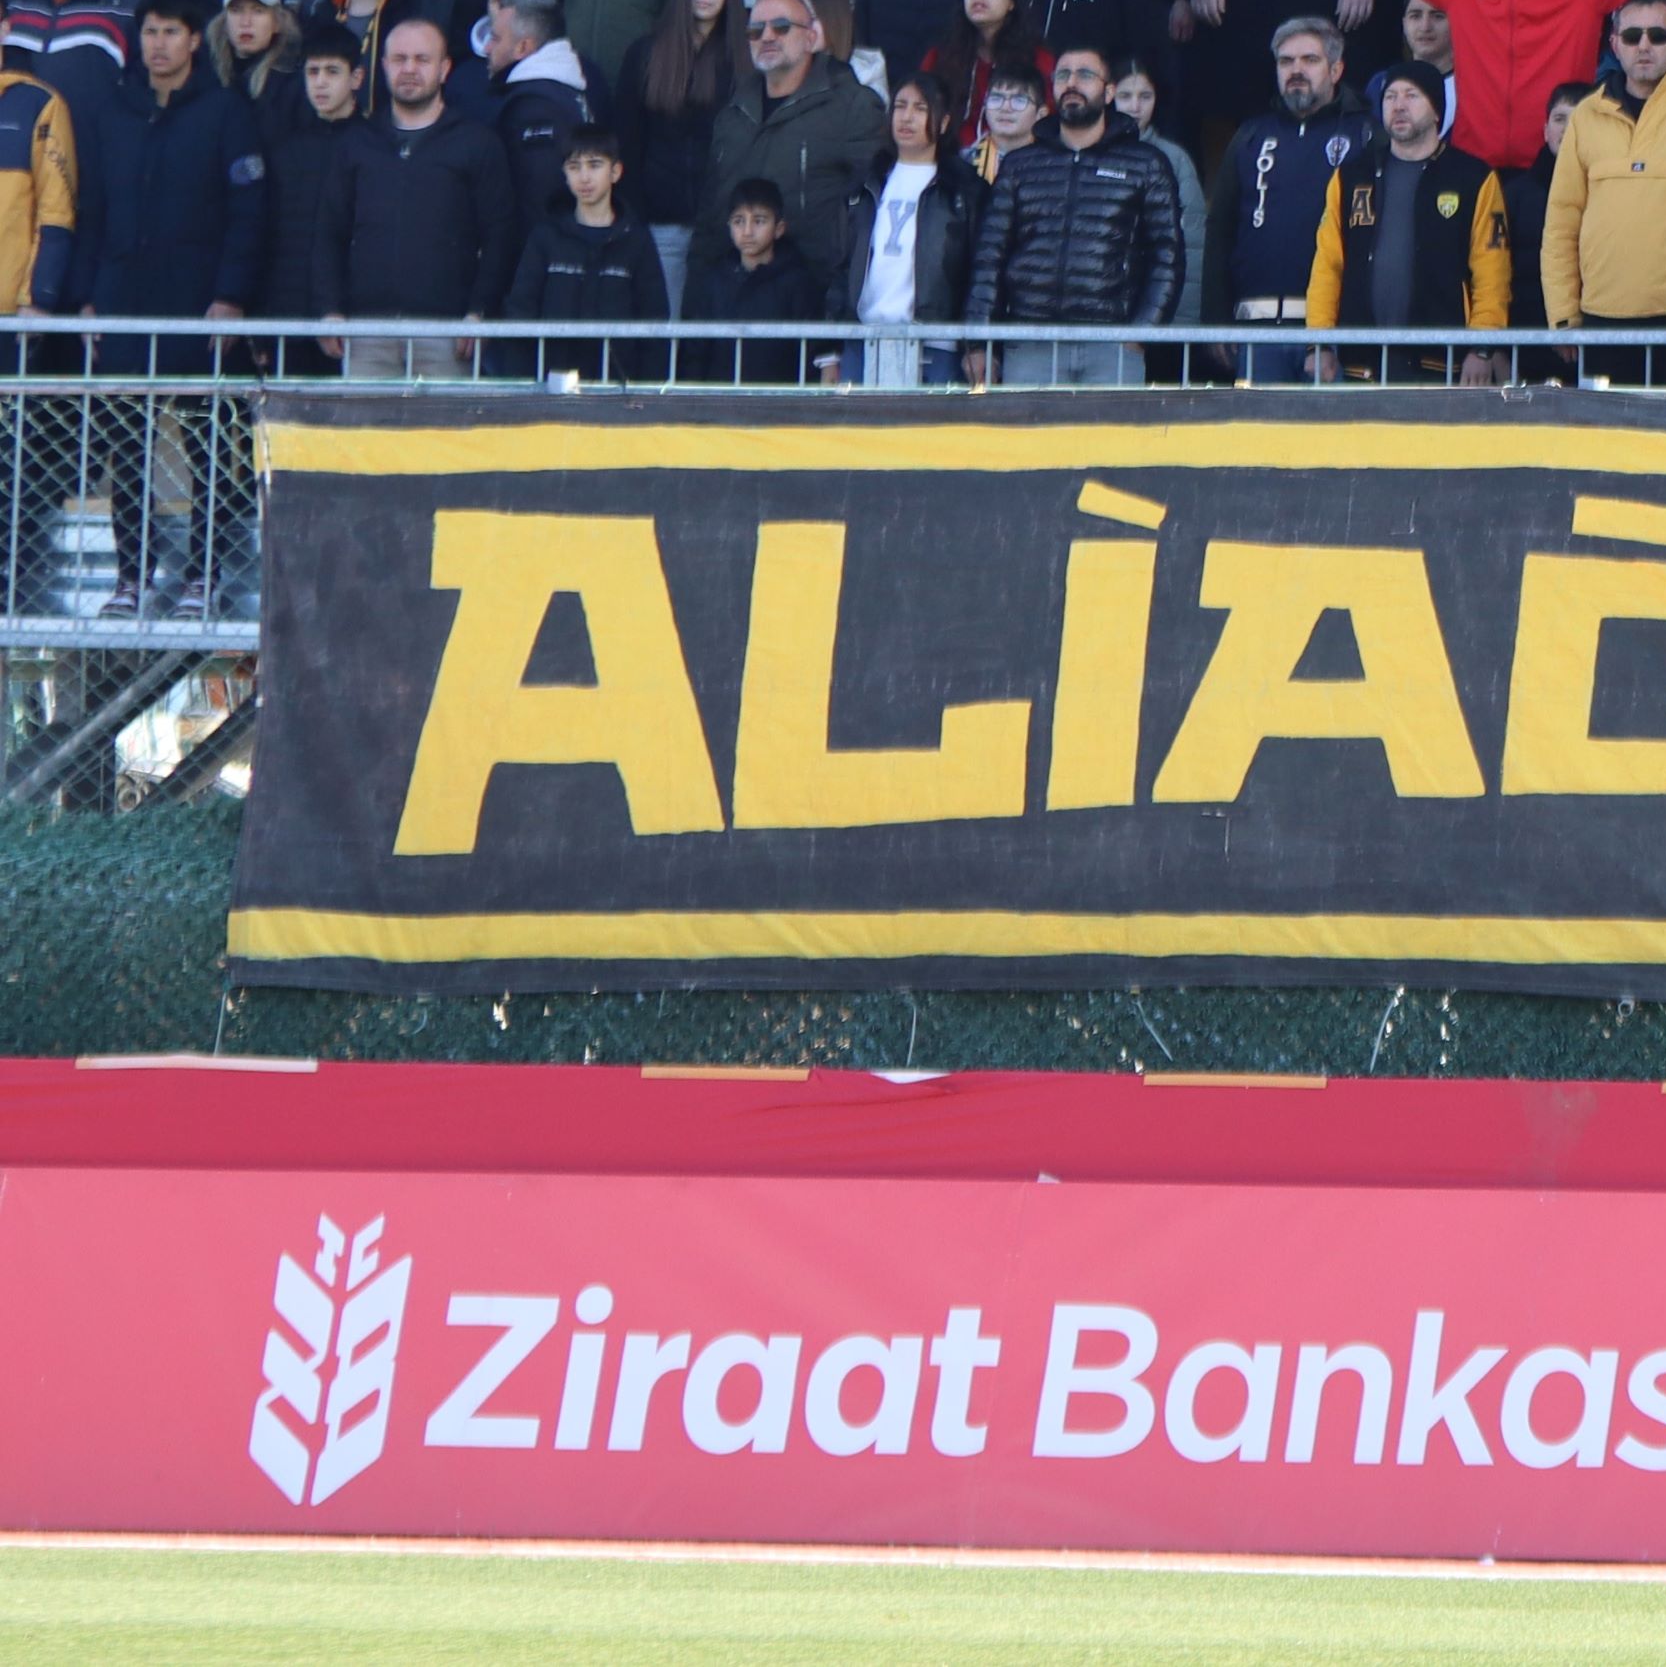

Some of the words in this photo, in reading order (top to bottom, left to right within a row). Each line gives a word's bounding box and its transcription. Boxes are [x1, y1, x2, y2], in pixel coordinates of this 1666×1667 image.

[1349, 183, 1375, 229] A
[1488, 211, 1509, 249] A
[424, 1284, 1003, 1458] Ziraat
